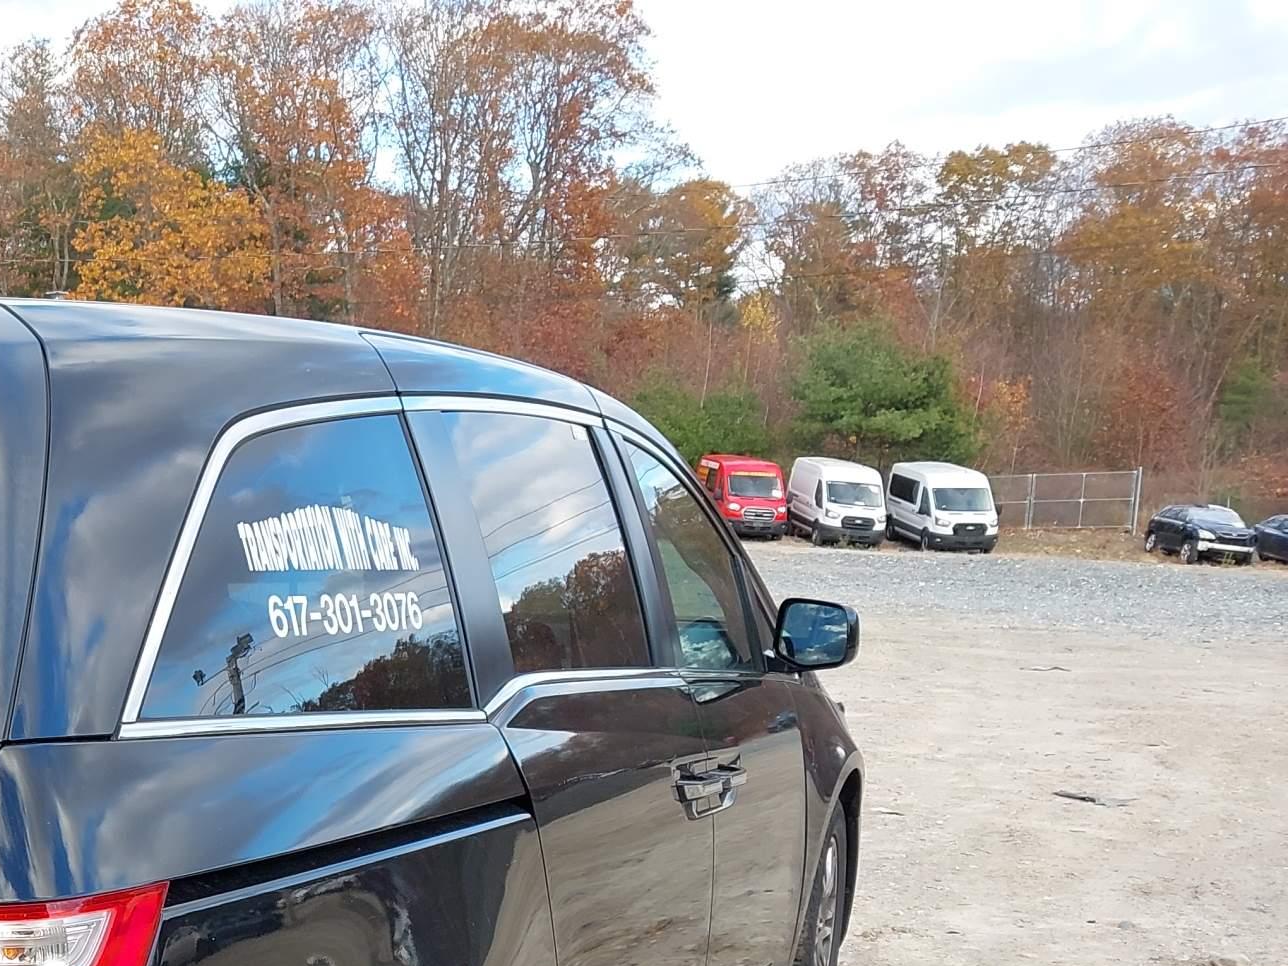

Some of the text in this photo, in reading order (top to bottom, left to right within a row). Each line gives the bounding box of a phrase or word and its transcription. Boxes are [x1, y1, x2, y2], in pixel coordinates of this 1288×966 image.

[237, 504, 420, 571] TRANSPORTATION WITH CARE INC.
[268, 591, 423, 638] 617-301-3076
